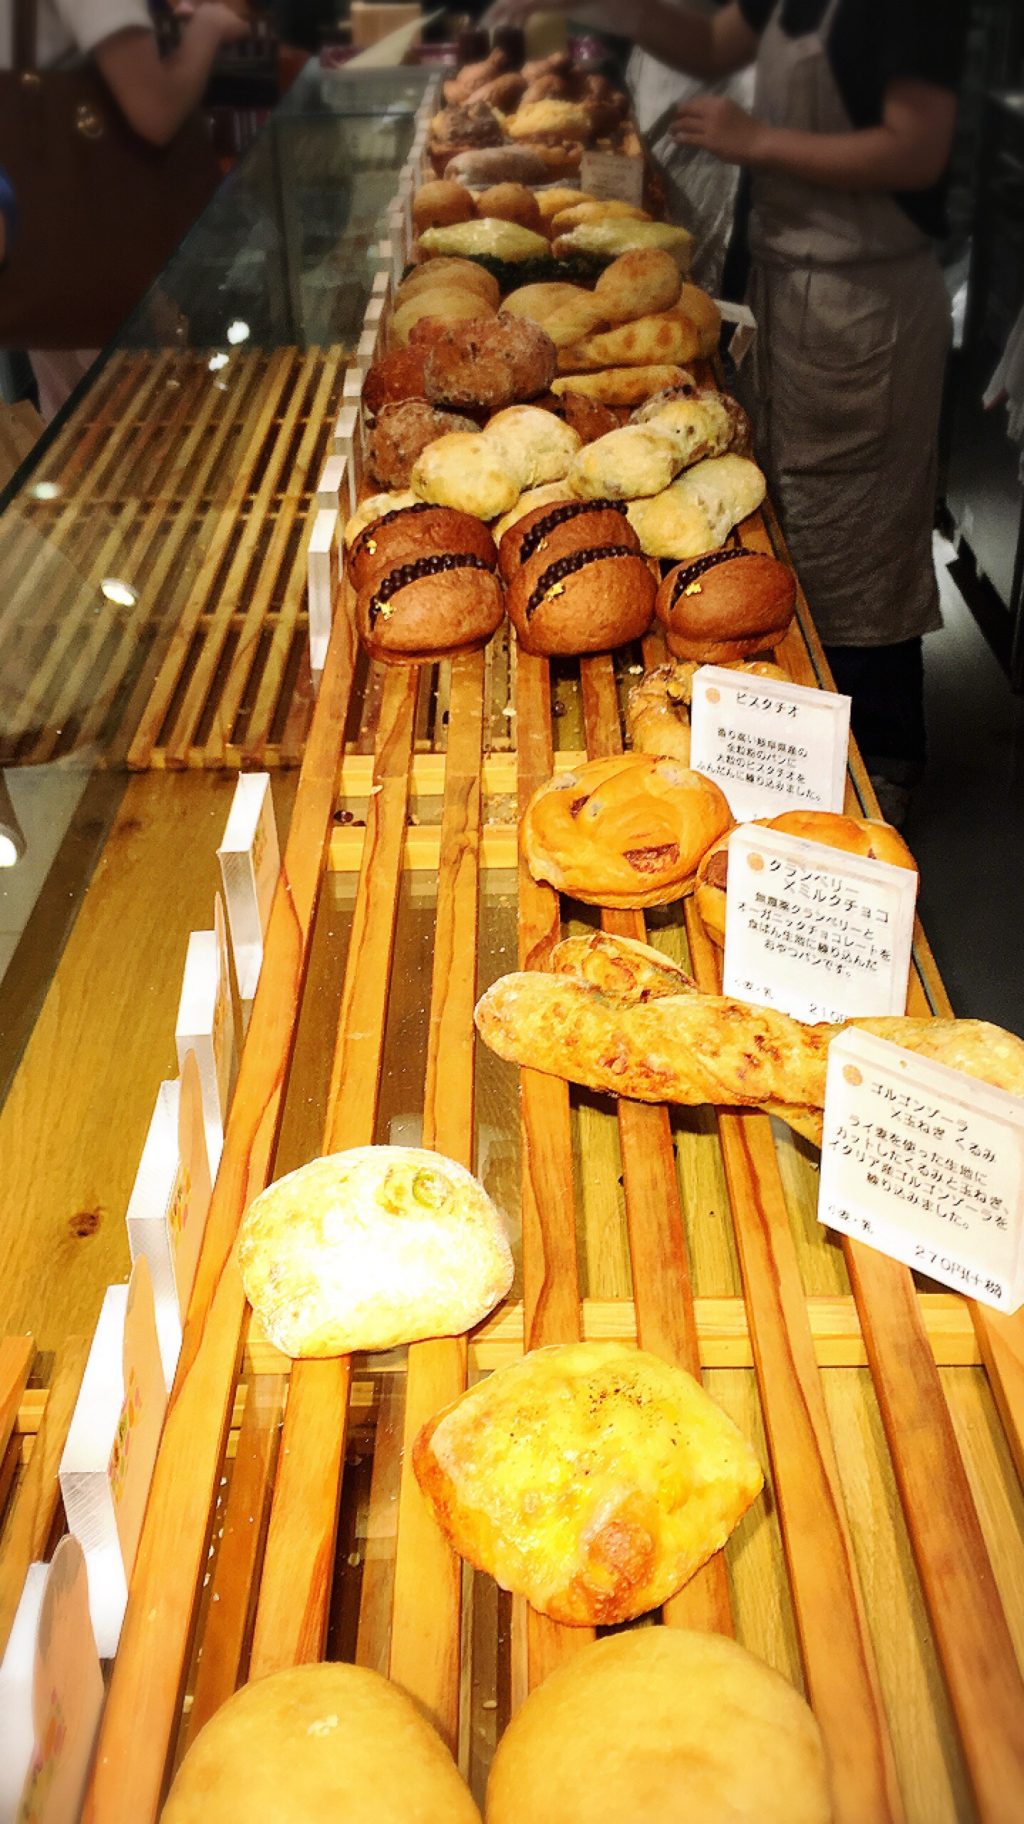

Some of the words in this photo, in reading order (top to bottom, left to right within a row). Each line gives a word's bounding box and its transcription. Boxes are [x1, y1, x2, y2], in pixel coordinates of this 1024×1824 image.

[737, 691, 798, 718] ピスタチオ
[716, 753, 806, 785] 大粒のピスタチオを
[727, 742, 797, 768] 全粒粉のパンに
[769, 859, 859, 895] クランベリー
[737, 901, 891, 963] オーガニックチョコレートを
[754, 891, 875, 940] 無農薬クランベリーと
[763, 938, 852, 978] おやつパンです。
[870, 1081, 969, 1133] ゴルゴンゾーラ
[849, 1113, 989, 1185] ライ麦を使った生地に
[829, 1139, 1008, 1231] イタリア産ゴルゴンゾーラを
[866, 1171, 970, 1231] 練り込みました。
